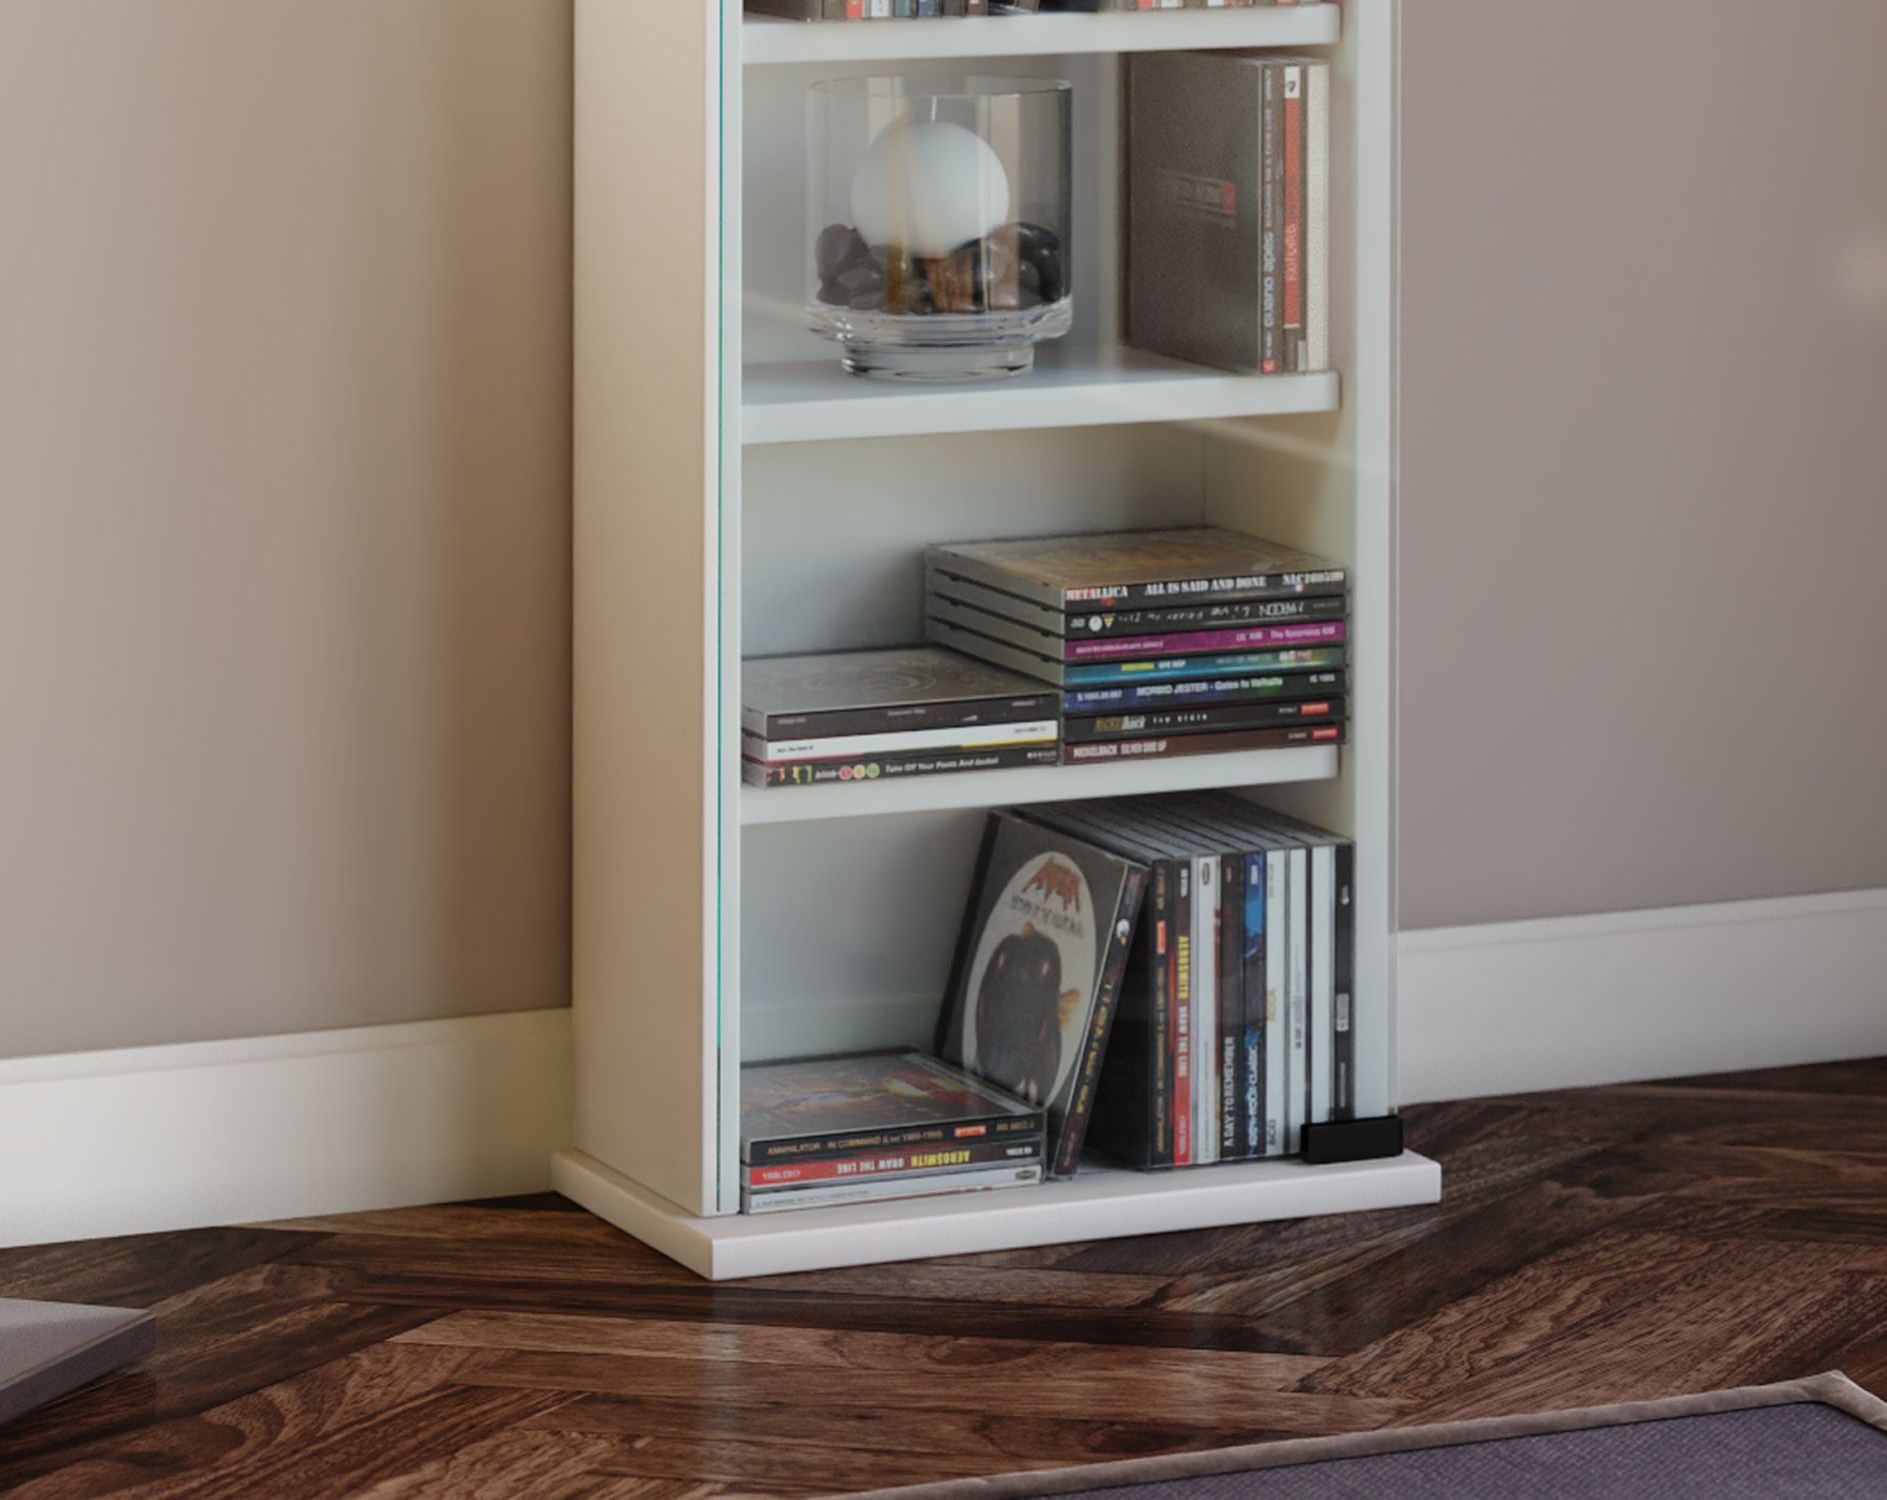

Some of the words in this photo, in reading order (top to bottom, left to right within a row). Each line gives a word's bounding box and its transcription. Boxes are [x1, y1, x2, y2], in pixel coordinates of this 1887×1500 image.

[1065, 585, 1130, 601] METALLICA
[1144, 582, 1166, 596] ALL
[1167, 581, 1180, 594] IS
[1180, 579, 1211, 593] SAID
[1210, 577, 1235, 592] AND
[1235, 575, 1267, 590] DONE
[1177, 934, 1190, 1000] AEROSMITH
[1177, 1005, 1190, 1033] DRAW
[1177, 1036, 1190, 1054] THE
[1177, 1056, 1190, 1077] LINE
[1223, 1138, 1235, 1147] A
[859, 1159, 876, 1173] THE
[877, 1156, 906, 1171] DRAW
[910, 1149, 971, 1168] AEROSMITH
[836, 1161, 858, 1175] LINE
